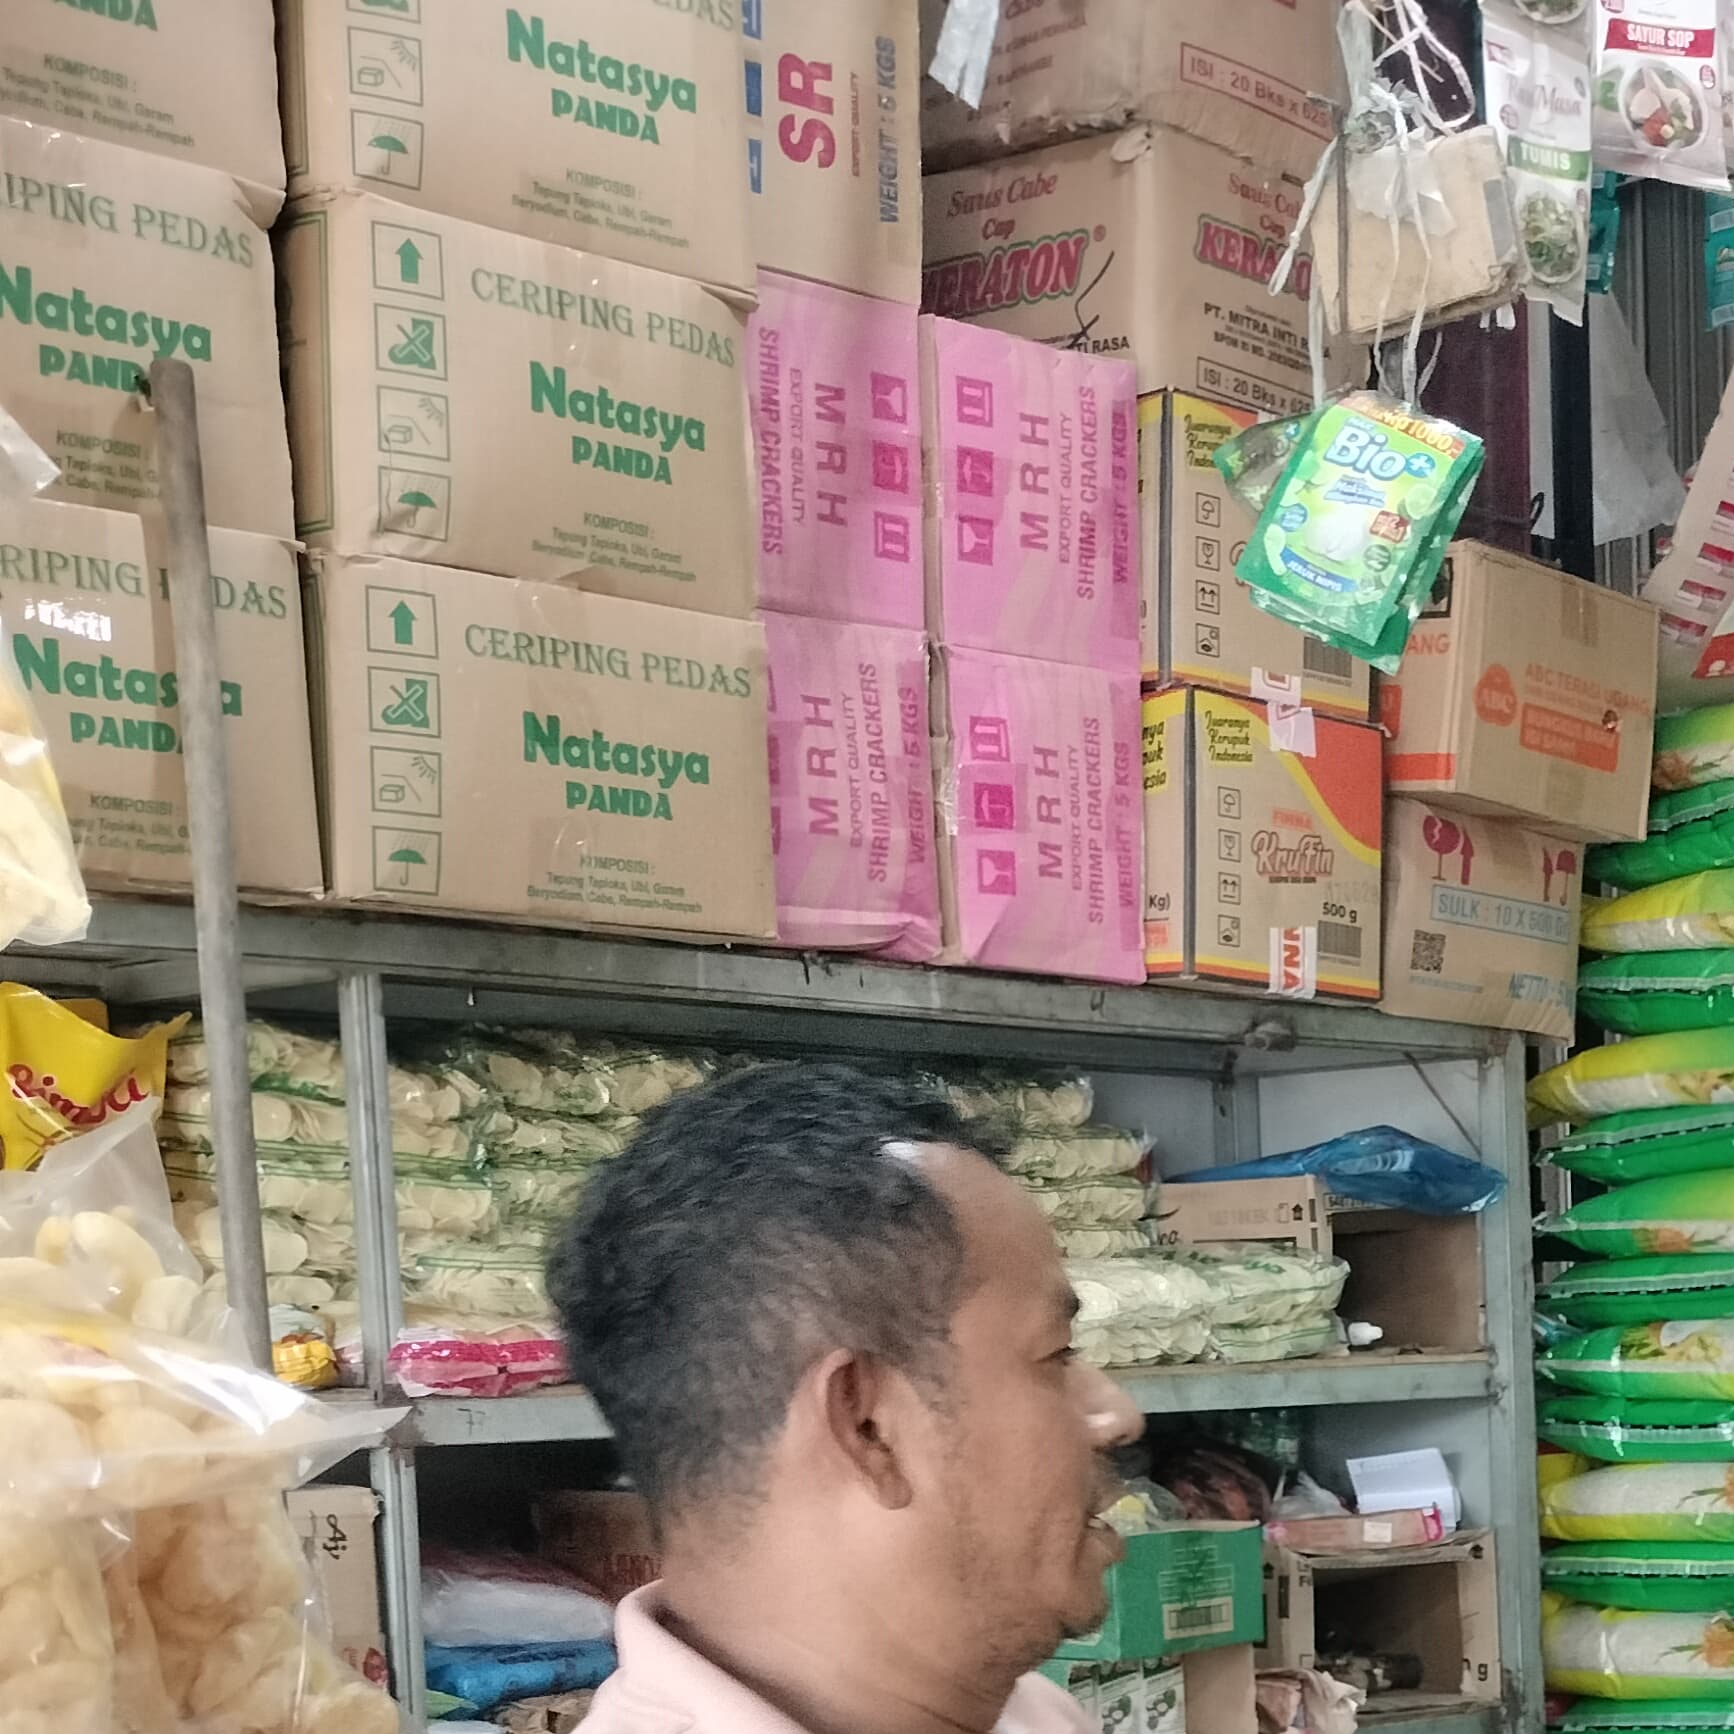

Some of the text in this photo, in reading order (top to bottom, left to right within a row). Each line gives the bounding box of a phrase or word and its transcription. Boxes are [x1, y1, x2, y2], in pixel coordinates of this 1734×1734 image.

[506, 9, 696, 114] Natasya
[875, 35, 899, 93] KGS
[1627, 24, 1695, 49] SAYUR SOP
[551, 88, 660, 145] PANDA
[778, 53, 836, 168] SR
[1191, 56, 1213, 81] ISI
[1230, 71, 1250, 93] 20
[1255, 80, 1285, 108] Bks
[878, 133, 899, 223] WEIGHT
[1007, 172, 1059, 205] Cabe
[1520, 142, 1571, 171] TUMIS
[132, 204, 253, 269] PEDAS
[0, 262, 212, 362] Natasya
[471, 267, 735, 368] CERIPING PEDAS
[1229, 310, 1269, 337] MITRA
[1272, 322, 1298, 343] INTI
[1302, 336, 1331, 360] RA
[39, 344, 152, 397] PAND
[530, 360, 705, 452] Natasya
[1204, 368, 1276, 407] ISI 20 Bks
[571, 435, 672, 486] PANDA
[759, 327, 783, 555] SHRIMP CRACKERS
[1058, 412, 1073, 564] EXPORT QUALITY
[1077, 384, 1097, 601] SHRIMP CRACKERS
[13, 633, 242, 717] Natasa
[465, 623, 751, 698] CERIPING PEDAS
[70, 712, 183, 754] PAND
[522, 710, 709, 788] Natasya
[842, 692, 863, 848] EXPORT QUALITY
[1113, 741, 1131, 785] KGS
[565, 780, 673, 821] PANDA
[858, 662, 891, 883] SHRIMP CRACKERS
[1066, 744, 1083, 891] EXPORT QUALITY
[1083, 716, 1104, 924] SHRIMP CRACKERS
[1115, 824, 1134, 908] WEIGHT
[1322, 902, 1358, 924] 500 g
[1438, 893, 1481, 919] SULK
[1495, 904, 1511, 927] 10
